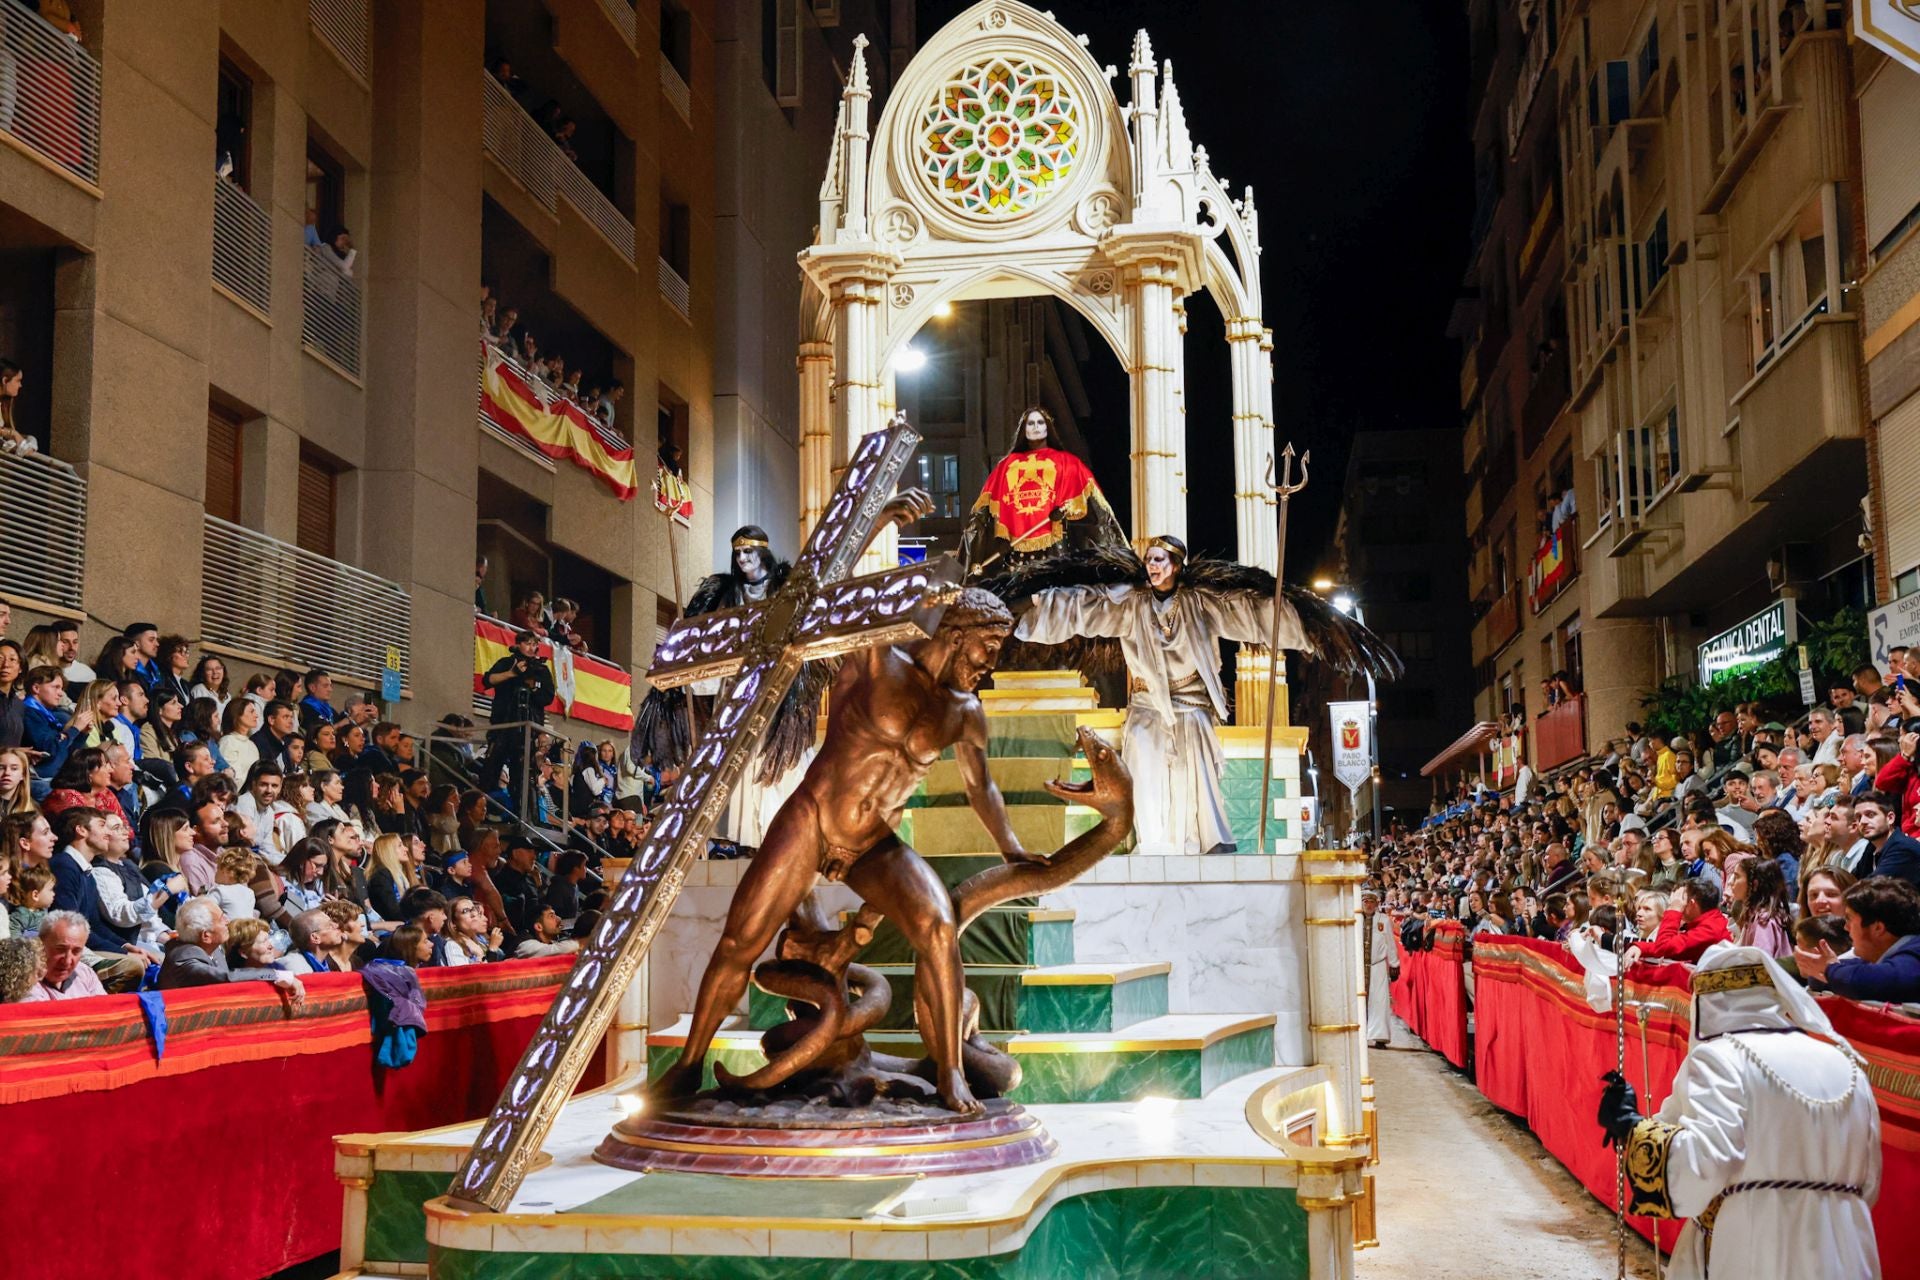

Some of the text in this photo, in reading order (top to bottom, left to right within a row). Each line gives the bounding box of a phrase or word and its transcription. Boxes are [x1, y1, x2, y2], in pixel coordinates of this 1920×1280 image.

[1746, 607, 1784, 652] DENTAL
[390, 656, 397, 669] 35
[1342, 752, 1361, 760] PASO
